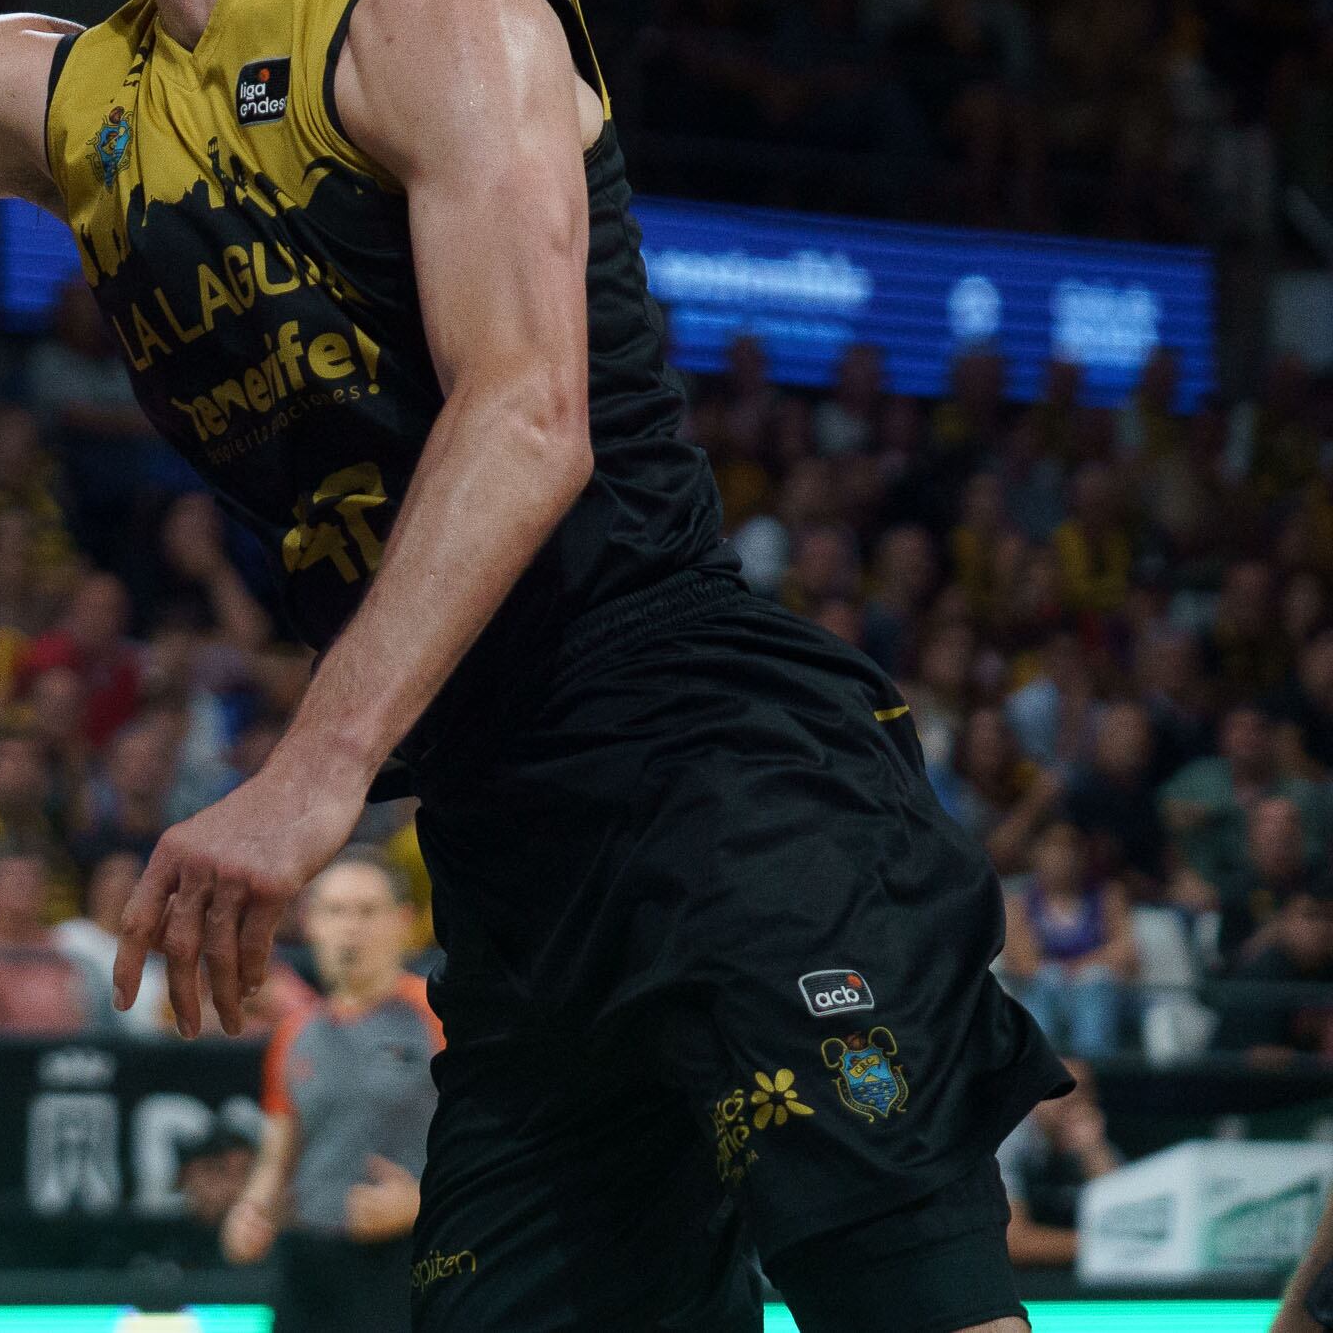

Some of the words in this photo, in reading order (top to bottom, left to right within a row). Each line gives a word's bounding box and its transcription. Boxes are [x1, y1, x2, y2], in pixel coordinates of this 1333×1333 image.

[240, 82, 266, 101] liga
[153, 241, 372, 344] LAGU
[816, 986, 860, 1008] acb
